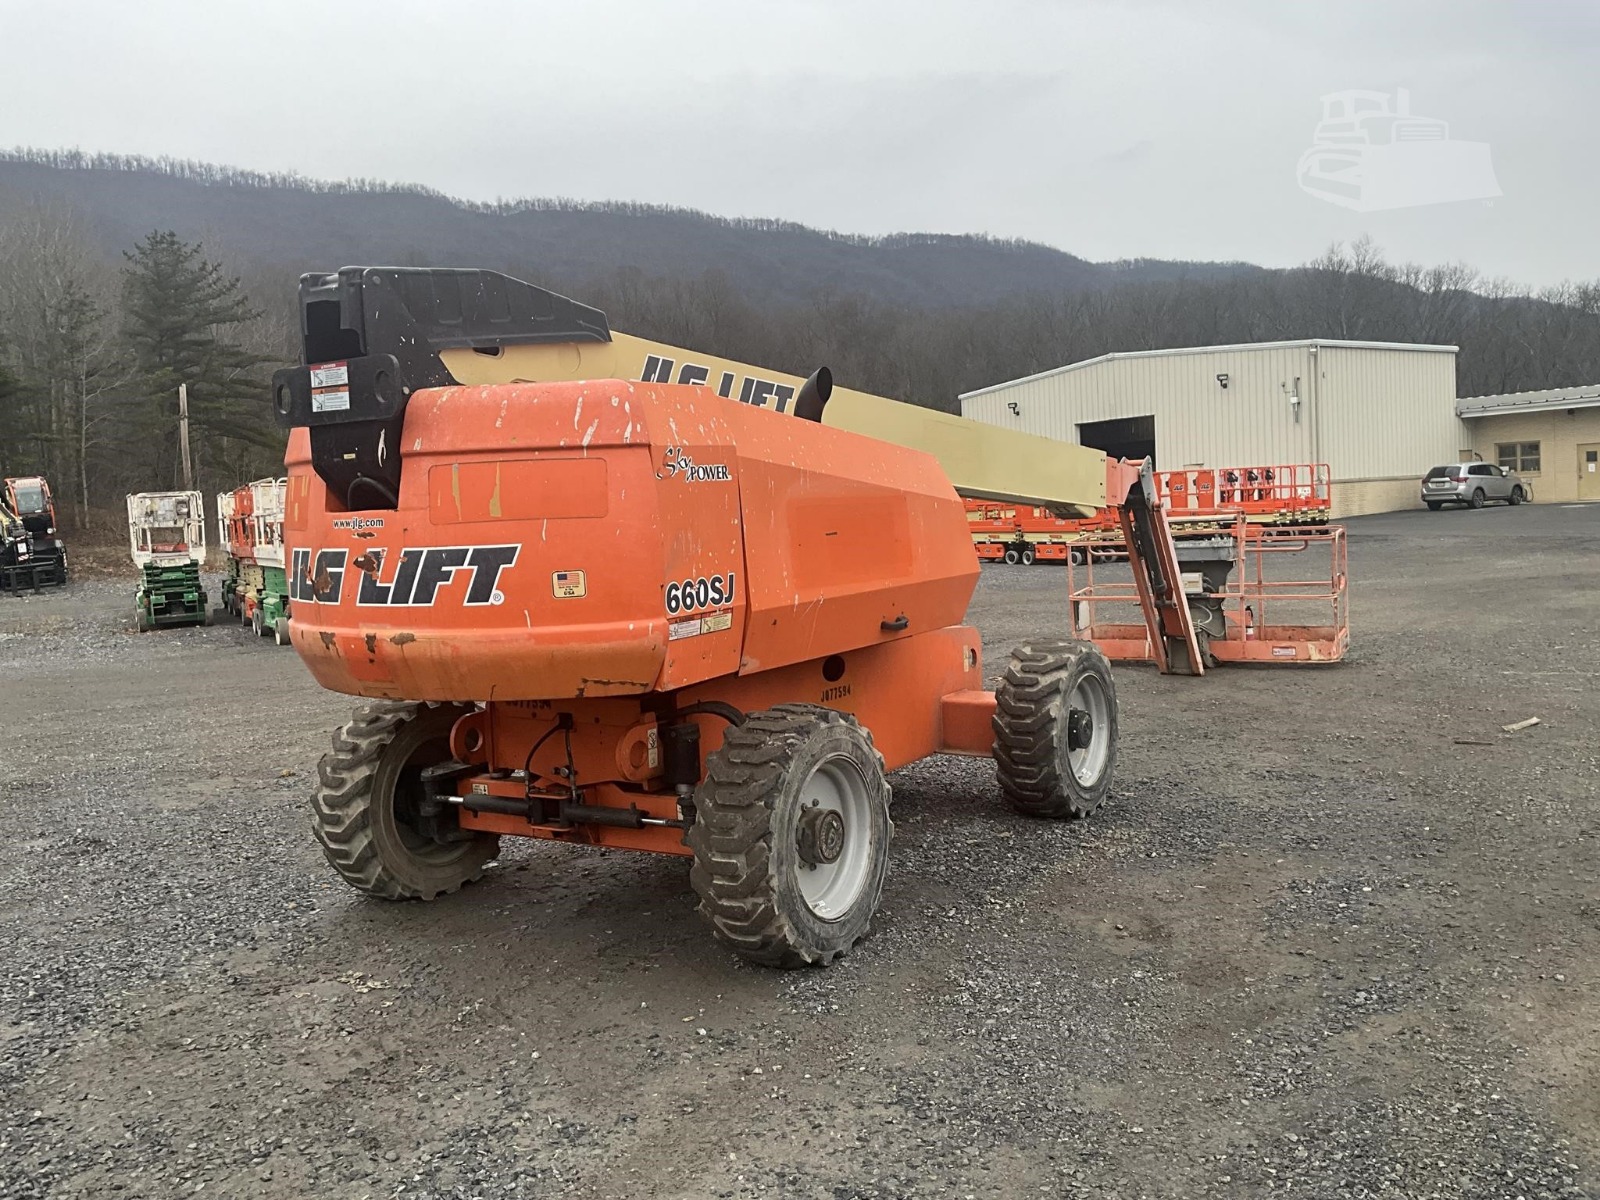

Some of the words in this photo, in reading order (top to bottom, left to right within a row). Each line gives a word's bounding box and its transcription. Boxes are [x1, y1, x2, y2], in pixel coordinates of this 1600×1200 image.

[690, 464, 729, 481] POWER
[333, 517, 384, 530] www.jlg.com
[289, 548, 349, 605] JLG
[665, 573, 735, 614] 660SJ
[821, 684, 851, 703] J077594
